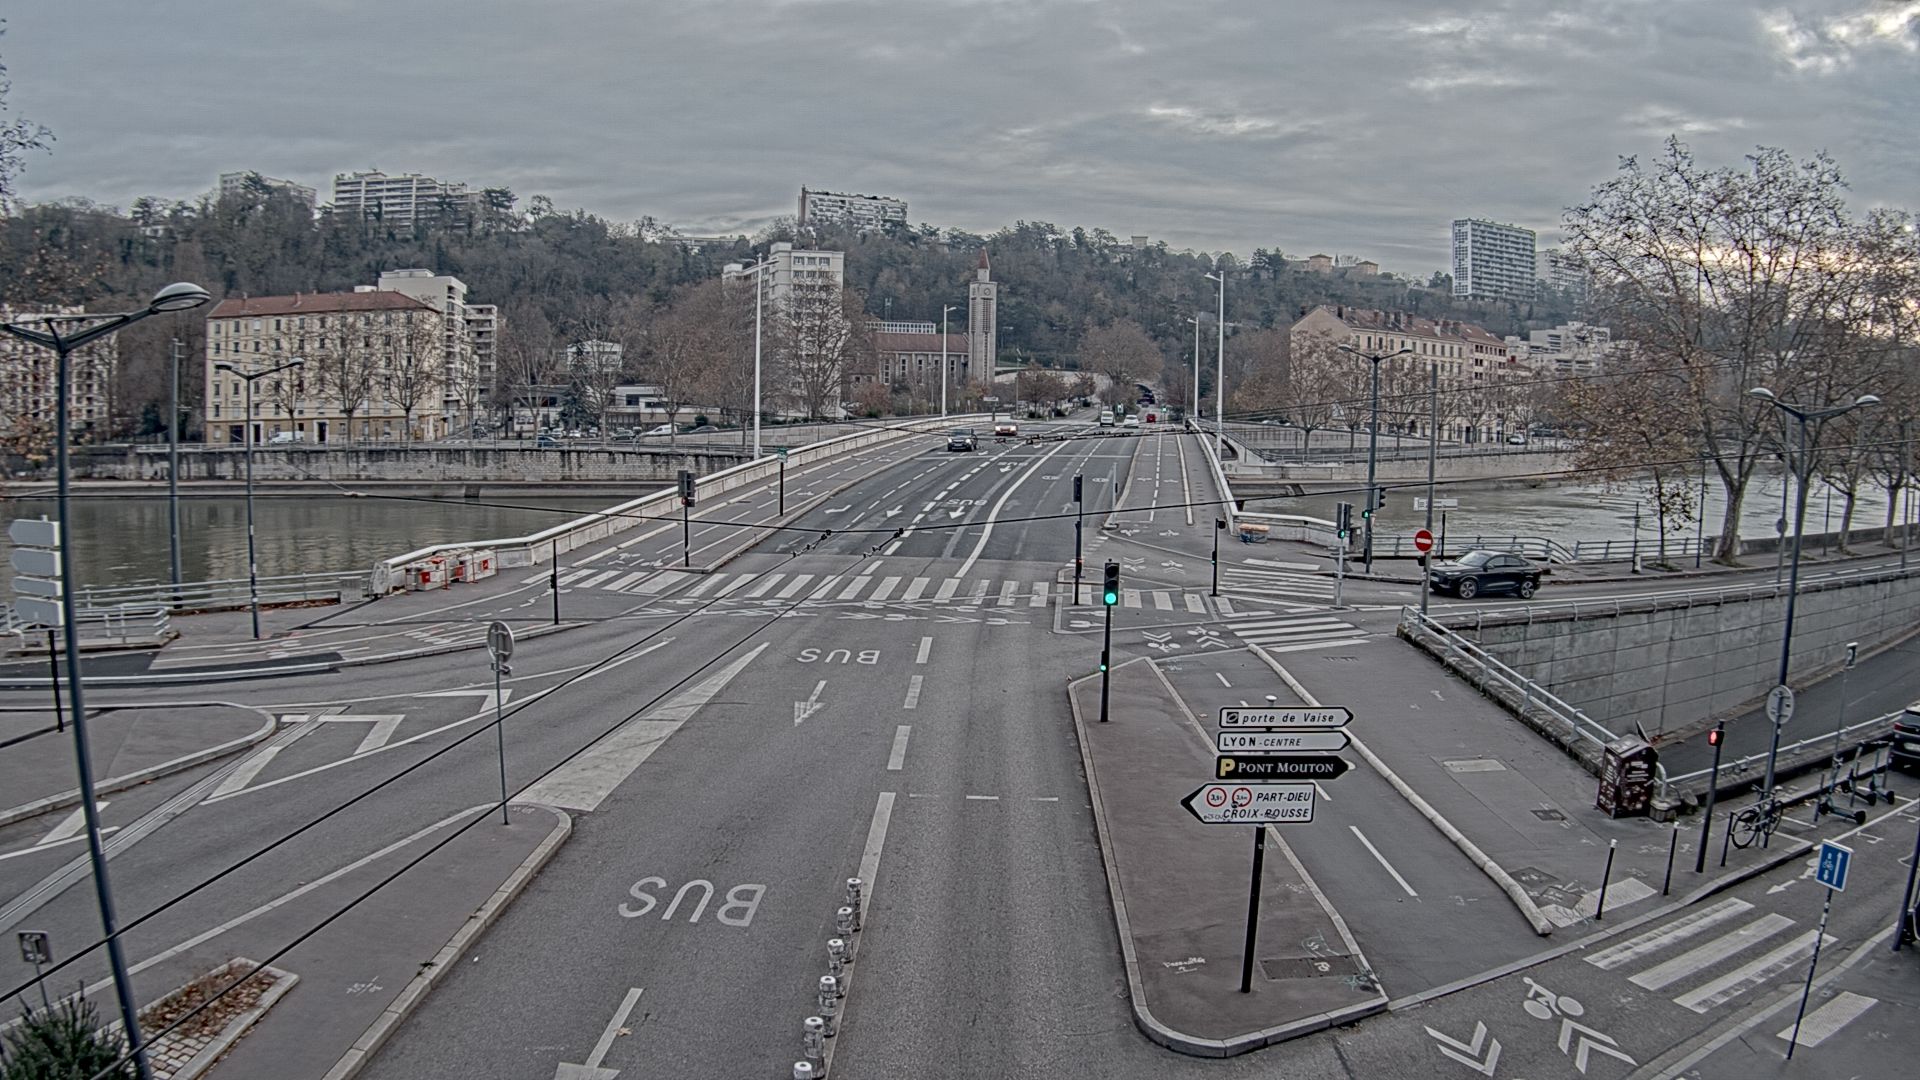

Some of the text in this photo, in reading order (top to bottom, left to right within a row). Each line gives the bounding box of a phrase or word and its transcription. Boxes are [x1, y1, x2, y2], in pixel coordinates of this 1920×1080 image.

[796, 648, 880, 664] BUS
[1242, 712, 1335, 725] porte de Vaise
[1219, 758, 1334, 777] P PONT MOUTON
[1256, 792, 1311, 802] PART-DIEU
[1223, 808, 1309, 818] CROIX-ROUSSE
[618, 876, 767, 927] BUS
